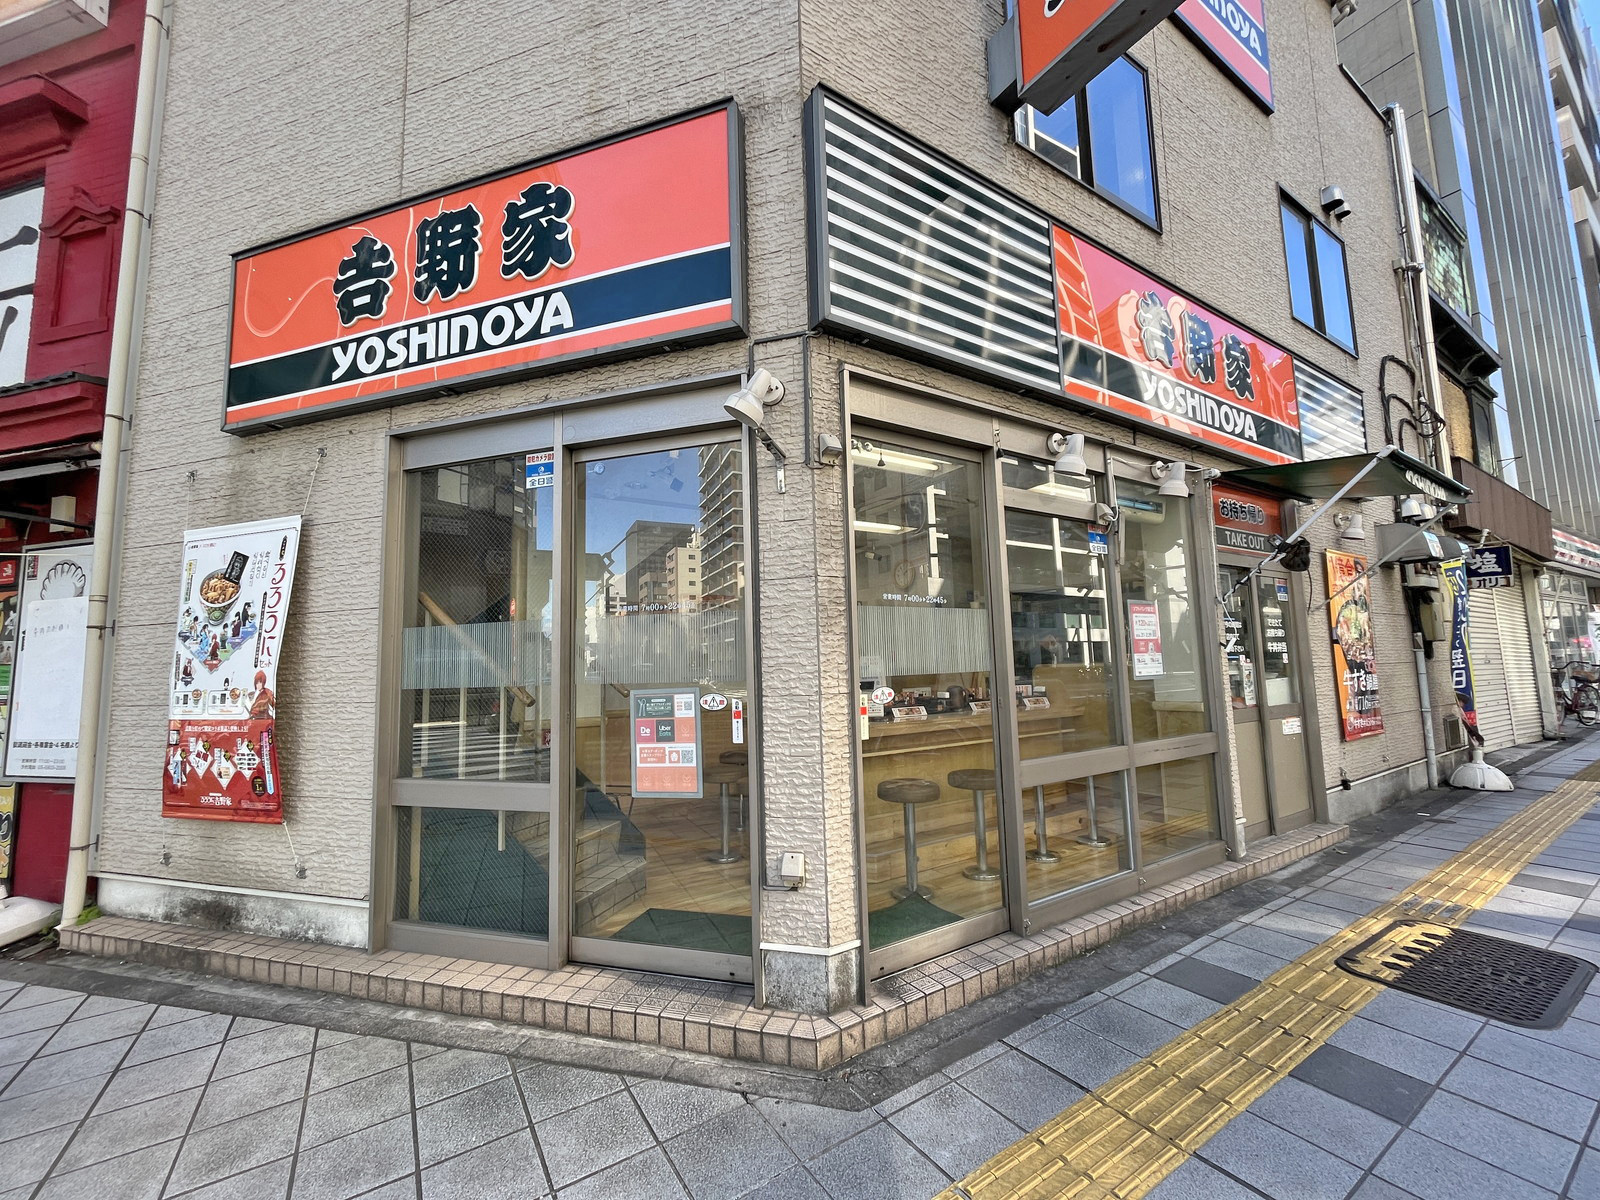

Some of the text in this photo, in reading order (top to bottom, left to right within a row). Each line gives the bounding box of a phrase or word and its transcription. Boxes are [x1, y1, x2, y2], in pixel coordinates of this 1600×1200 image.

[1209, 0, 1262, 57] NOYA
[333, 182, 576, 327] 吉野家
[331, 291, 574, 382] YOSHINOYA
[1136, 291, 1256, 401] 吉野家
[1142, 370, 1258, 442] YOSHINOYA
[1219, 498, 1265, 525] お持ち帰り
[1225, 531, 1265, 550] TAKE OUT
[1469, 551, 1503, 574] 塩
[640, 726, 651, 734] De
